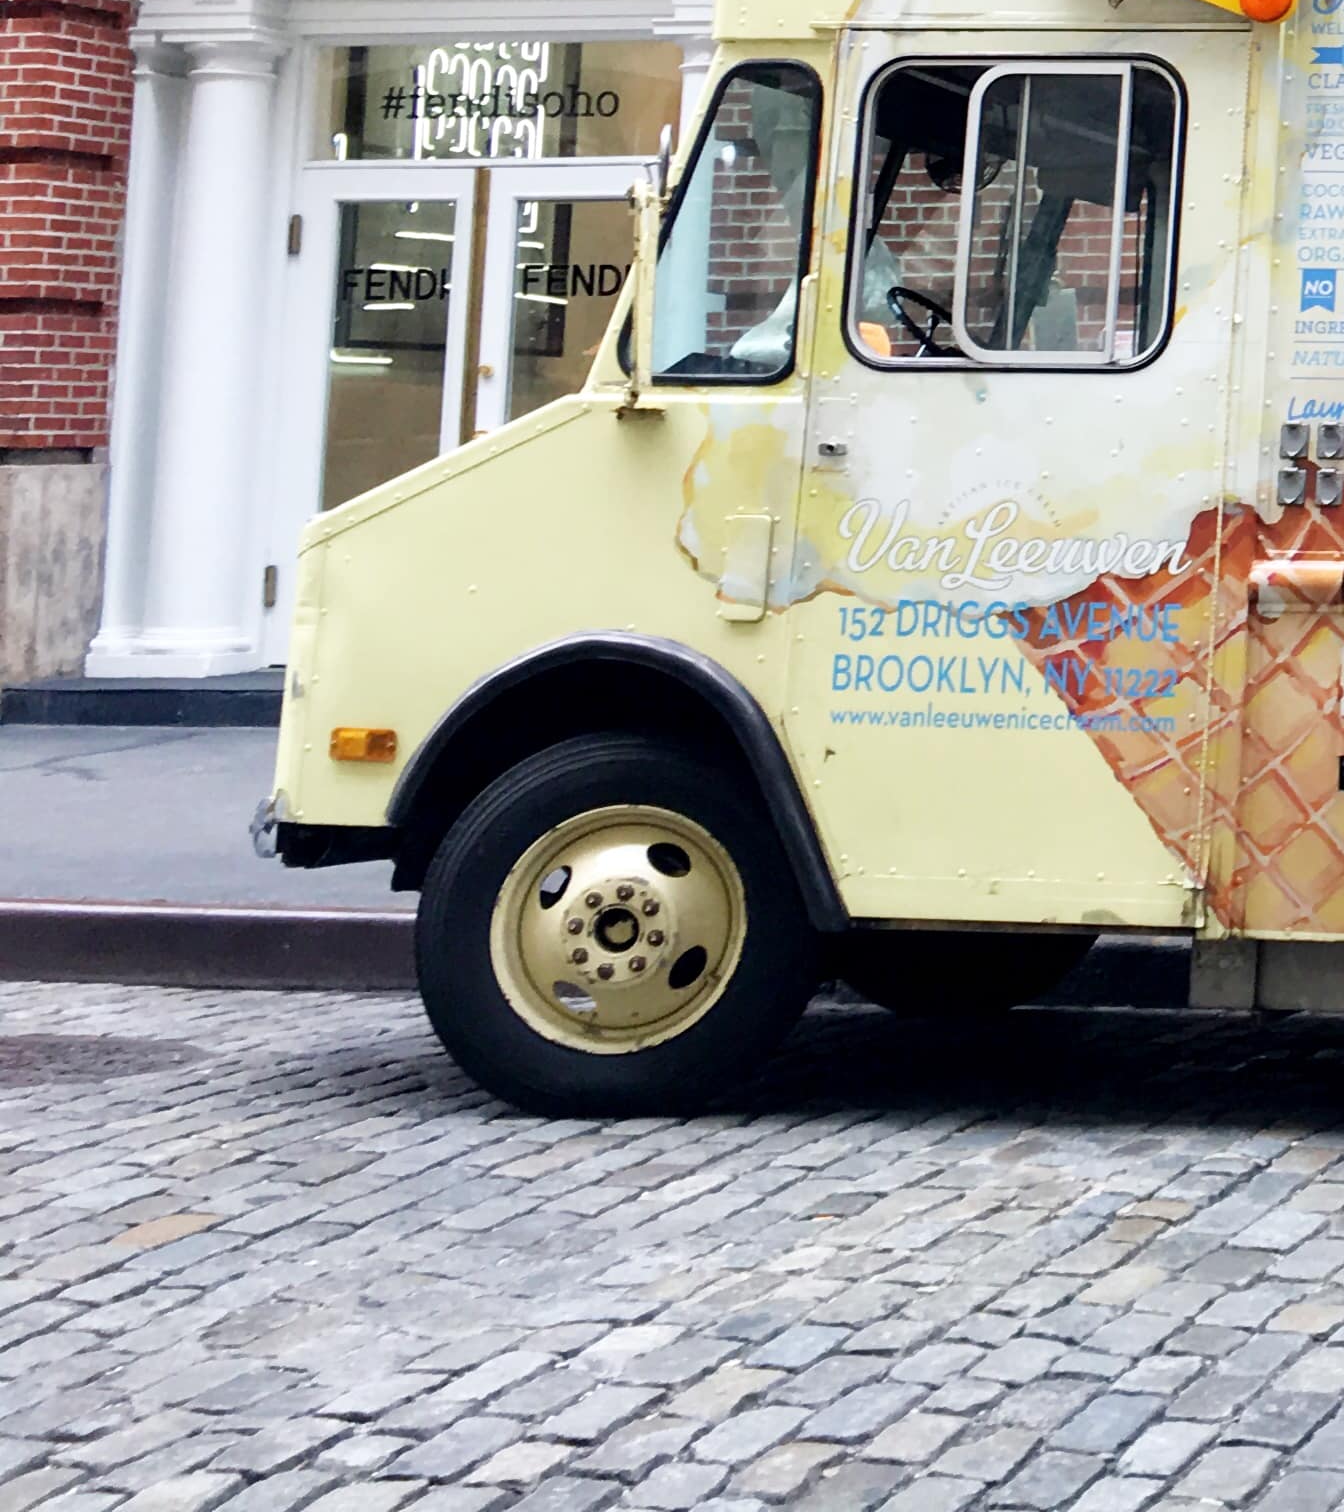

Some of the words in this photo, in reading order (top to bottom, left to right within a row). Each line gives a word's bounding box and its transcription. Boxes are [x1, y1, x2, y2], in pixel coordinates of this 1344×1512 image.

[379, 84, 620, 120] #fendisoho
[1303, 279, 1334, 296] NO
[839, 497, 962, 574] Van
[938, 500, 1193, 592] Leeuwen
[838, 606, 885, 641] 152
[896, 600, 1031, 641] DRIGGS
[1039, 602, 1183, 644] AVENUE
[831, 654, 1031, 698] BROOKLYN,
[1044, 657, 1095, 695] NY
[1103, 667, 1179, 698] 11222
[829, 701, 1176, 733] www.vanleeuwenicecream.com
